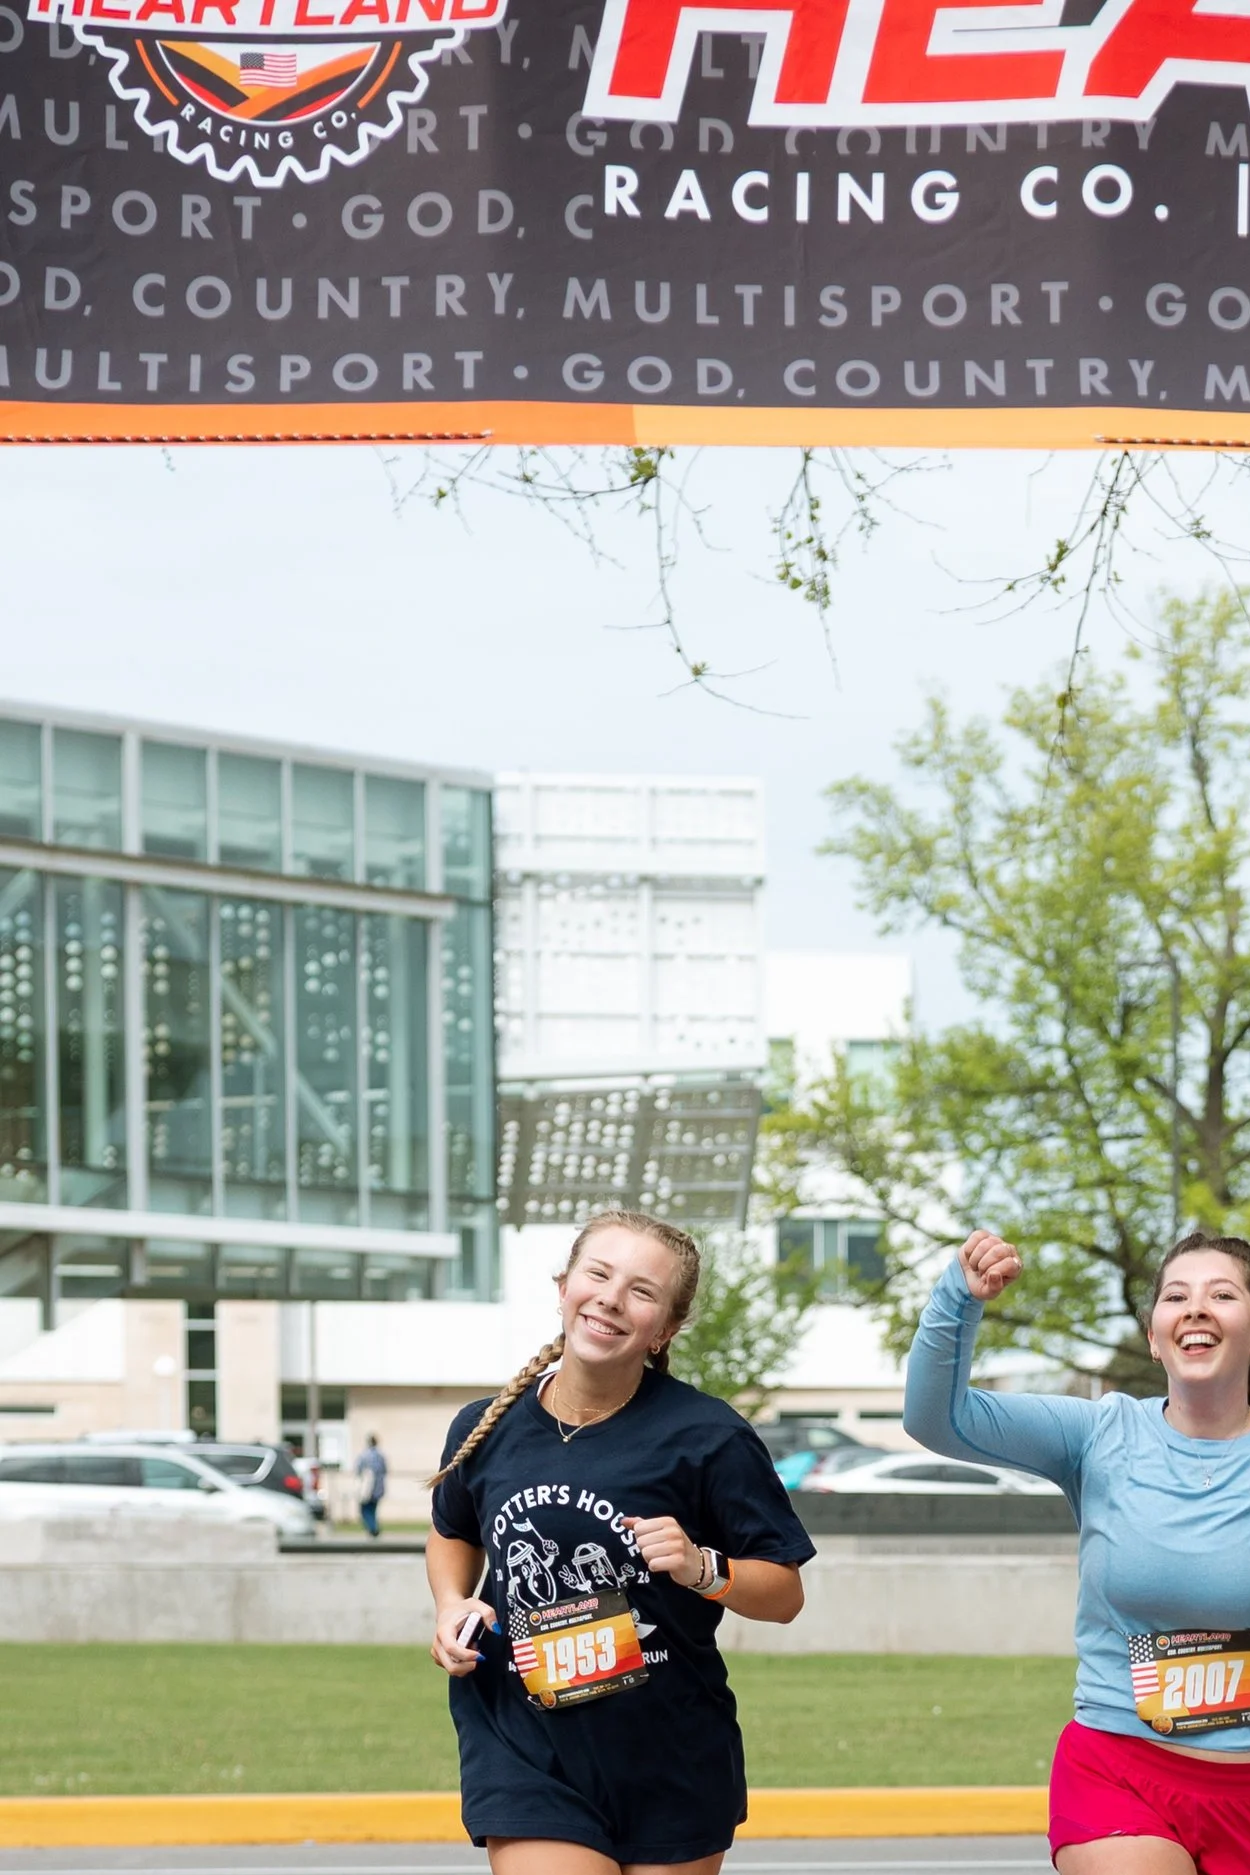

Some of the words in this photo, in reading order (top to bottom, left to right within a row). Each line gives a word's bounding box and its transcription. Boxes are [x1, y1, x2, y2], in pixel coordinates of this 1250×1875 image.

[180, 103, 294, 150] RACING
[313, 111, 357, 138] CO.
[342, 189, 525, 241] GOD,
[605, 165, 960, 223] RACING
[1021, 165, 1169, 221] CO.
[132, 272, 525, 322] COUNTRY,
[562, 276, 1070, 328] MULTISPORT
[0, 346, 484, 394] ULTISPORT
[561, 352, 745, 400] GOD,
[783, 357, 1168, 401] COUNTRY,
[492, 1484, 571, 1550] POTTER'S
[637, 1570, 650, 1584] 26
[542, 1626, 617, 1684] 1953
[642, 1649, 669, 1665] RUN
[1162, 1659, 1245, 1711] 2007
